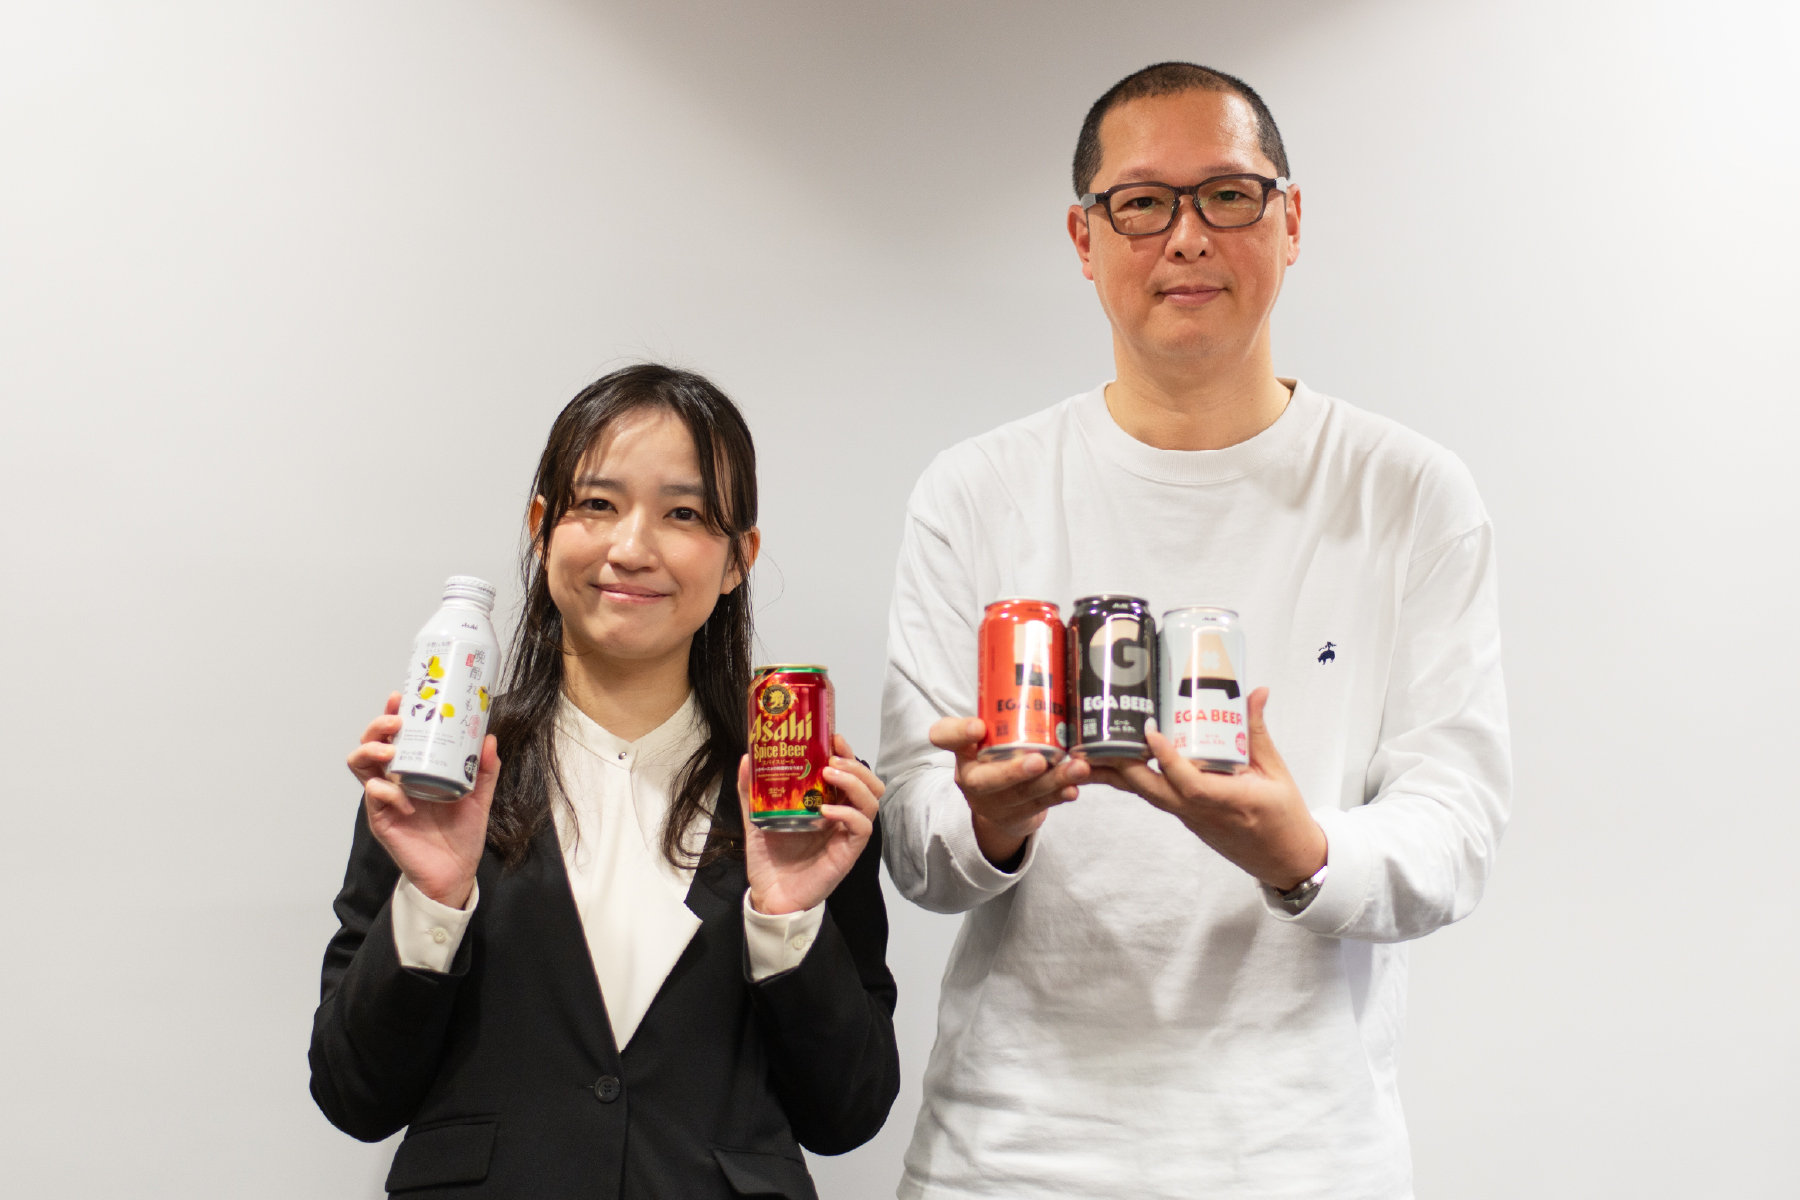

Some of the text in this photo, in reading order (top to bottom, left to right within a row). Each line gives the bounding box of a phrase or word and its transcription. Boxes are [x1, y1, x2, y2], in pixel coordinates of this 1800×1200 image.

[1089, 619, 1150, 687] G
[1179, 634, 1240, 699] A
[1083, 695, 1154, 714] EGA BEER
[1174, 709, 1243, 725] EGA BEER
[749, 711, 812, 744] Asahi
[754, 742, 807, 763] Spice Beer
